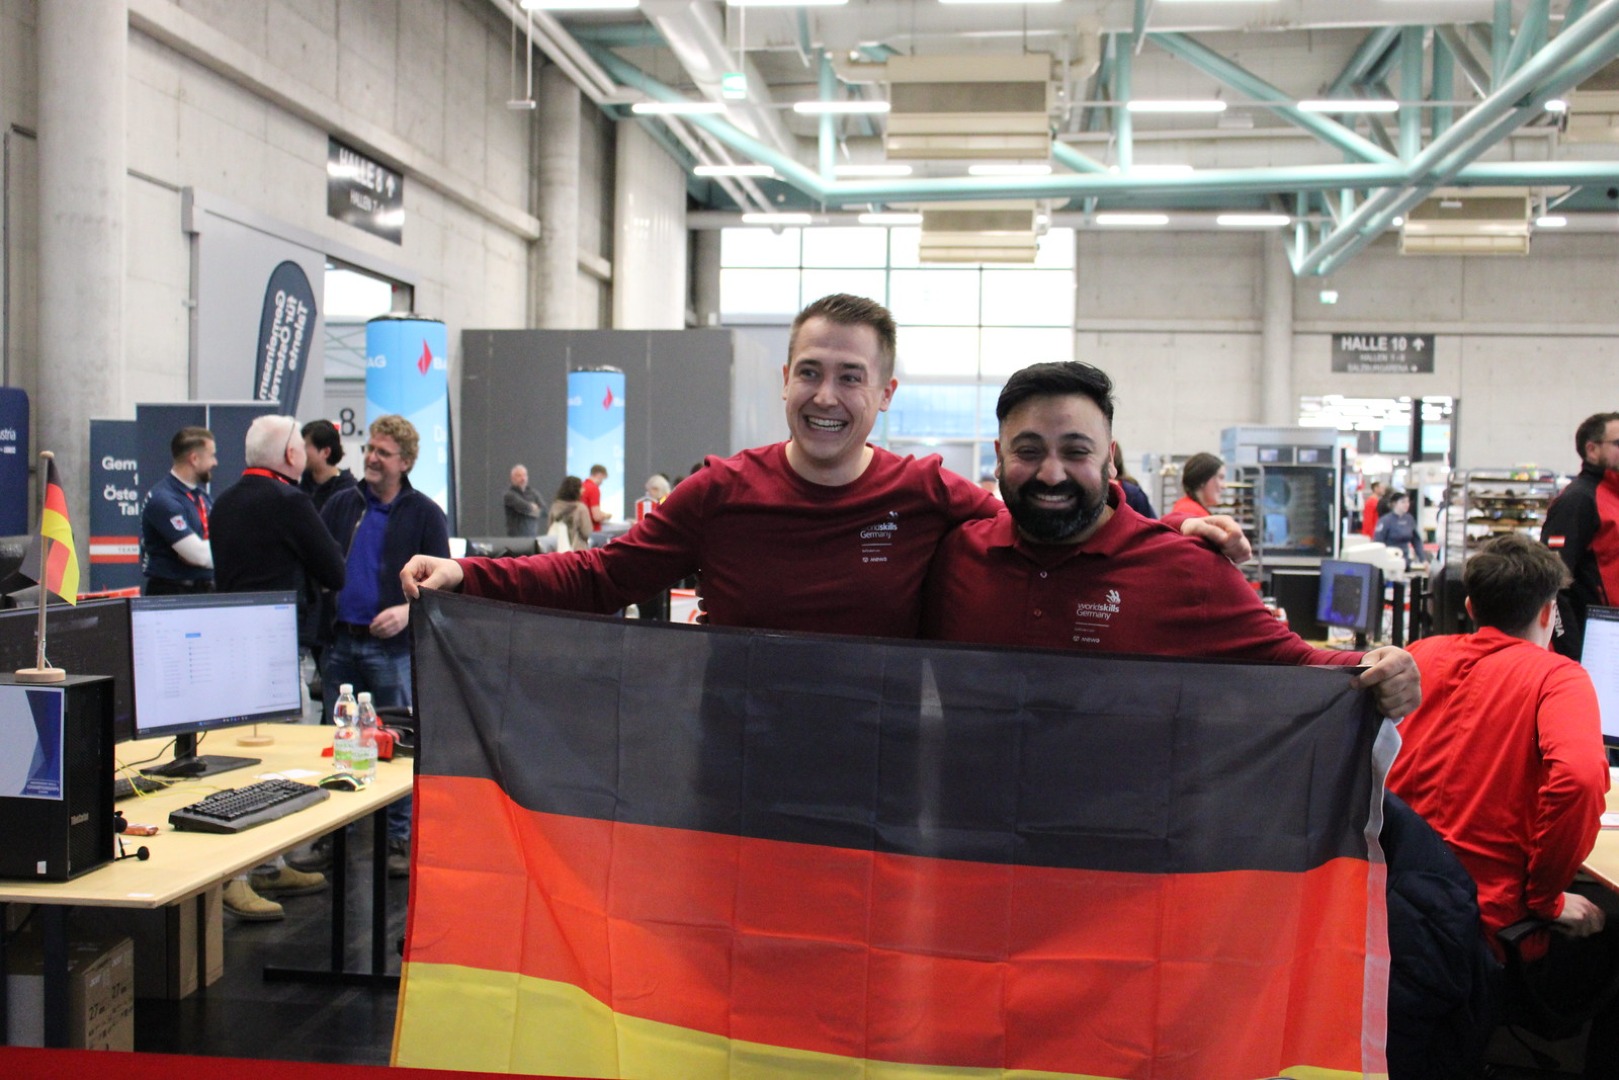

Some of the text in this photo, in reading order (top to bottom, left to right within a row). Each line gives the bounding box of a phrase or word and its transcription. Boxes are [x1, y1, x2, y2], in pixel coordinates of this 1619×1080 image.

[1341, 336, 1407, 351] HALLE 10
[102, 456, 138, 471] Gem
[103, 484, 138, 501] Öste
[118, 502, 139, 515] Tal
[860, 530, 892, 539] Germany
[1076, 609, 1111, 620] Germany
[1077, 603, 1120, 613] worldskills
